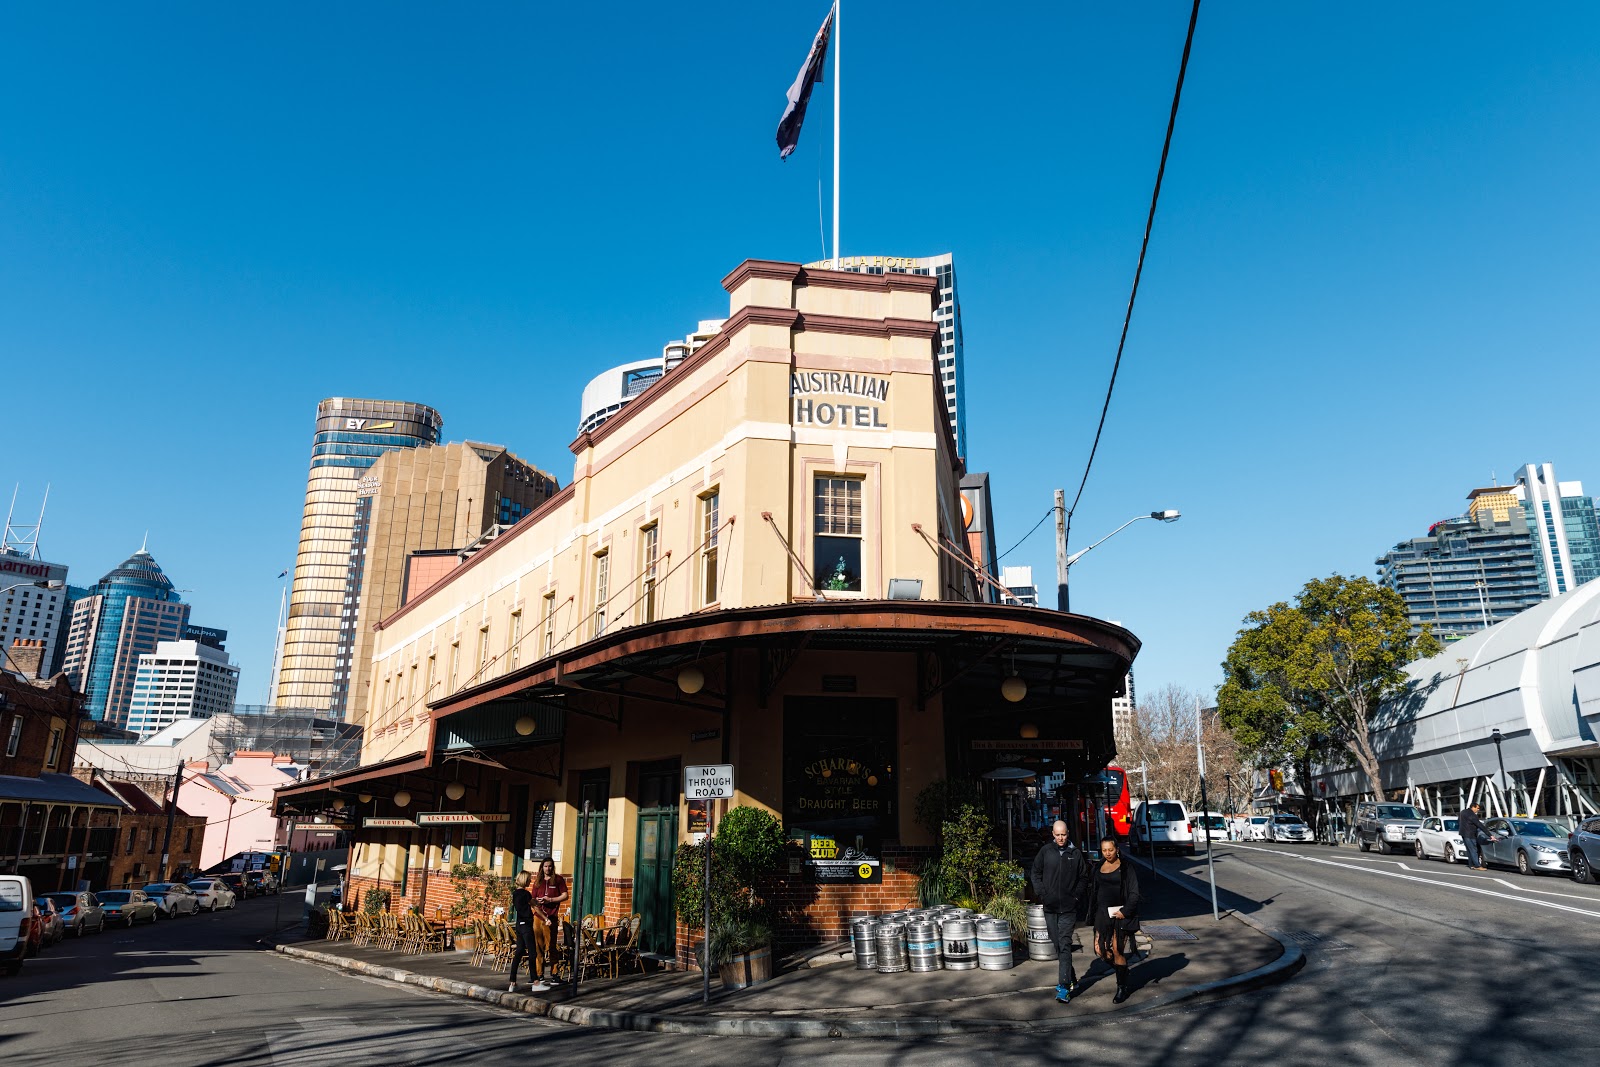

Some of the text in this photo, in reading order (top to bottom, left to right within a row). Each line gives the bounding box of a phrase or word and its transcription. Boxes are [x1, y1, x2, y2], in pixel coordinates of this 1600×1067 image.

[873, 257, 920, 269] HOTEL
[791, 371, 890, 402] AUSTRALIAN
[796, 399, 887, 428] HOTEL
[346, 419, 366, 430] EY
[0, 561, 50, 577] arriott
[702, 768, 716, 776] NO
[688, 777, 731, 787] THROUGH
[816, 776, 862, 785] BAVARIAN
[695, 788, 724, 797] ROAD
[824, 786, 853, 795] STYLE
[799, 797, 879, 809] DRAUGHT BEER
[810, 839, 837, 849] BEER
